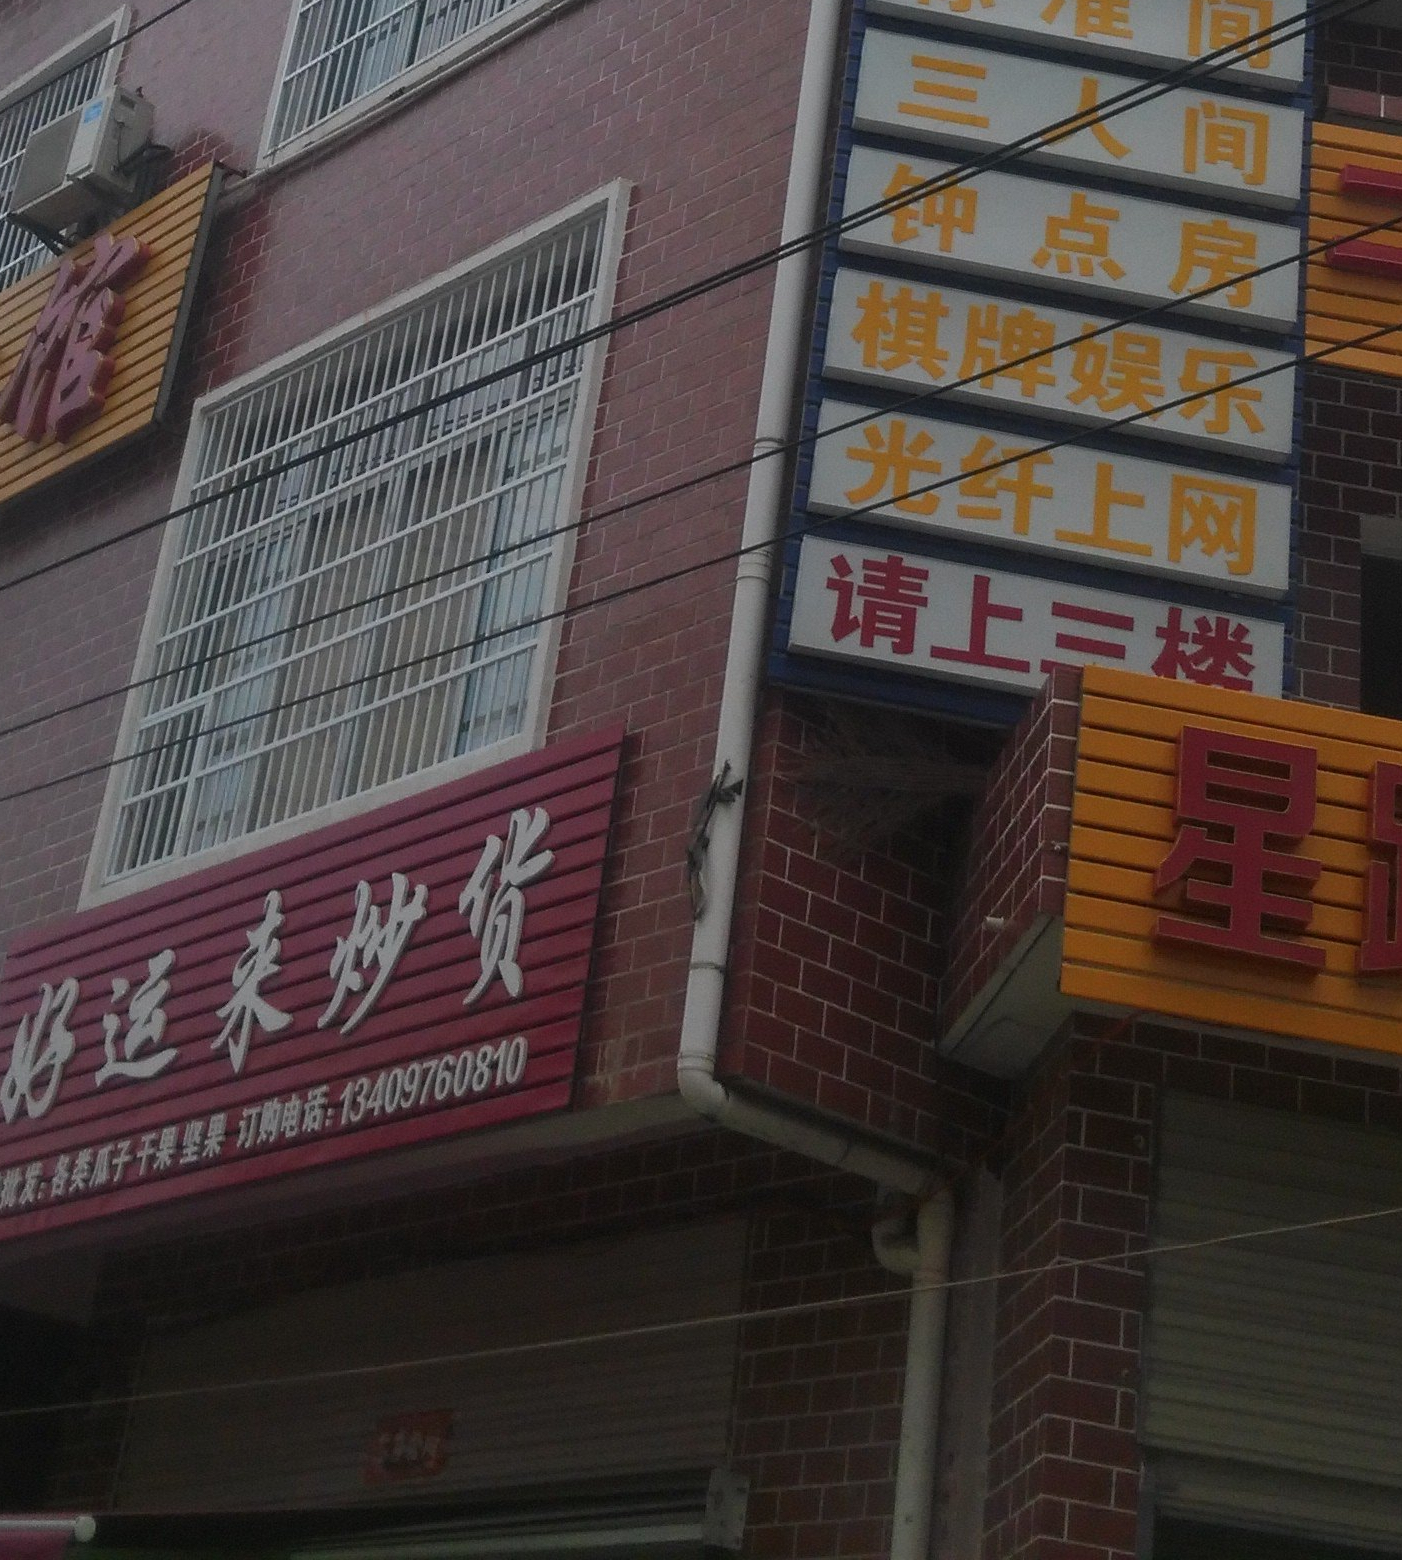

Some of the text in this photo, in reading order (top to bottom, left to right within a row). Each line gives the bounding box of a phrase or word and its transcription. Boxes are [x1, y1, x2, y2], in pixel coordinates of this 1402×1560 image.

[898, 54, 1270, 186] 三人间
[881, 162, 1259, 308] 钟点房
[851, 280, 1266, 439] 棋牌娱乐
[844, 419, 1259, 576] 光纤上网
[826, 554, 1257, 692] 请上三楼
